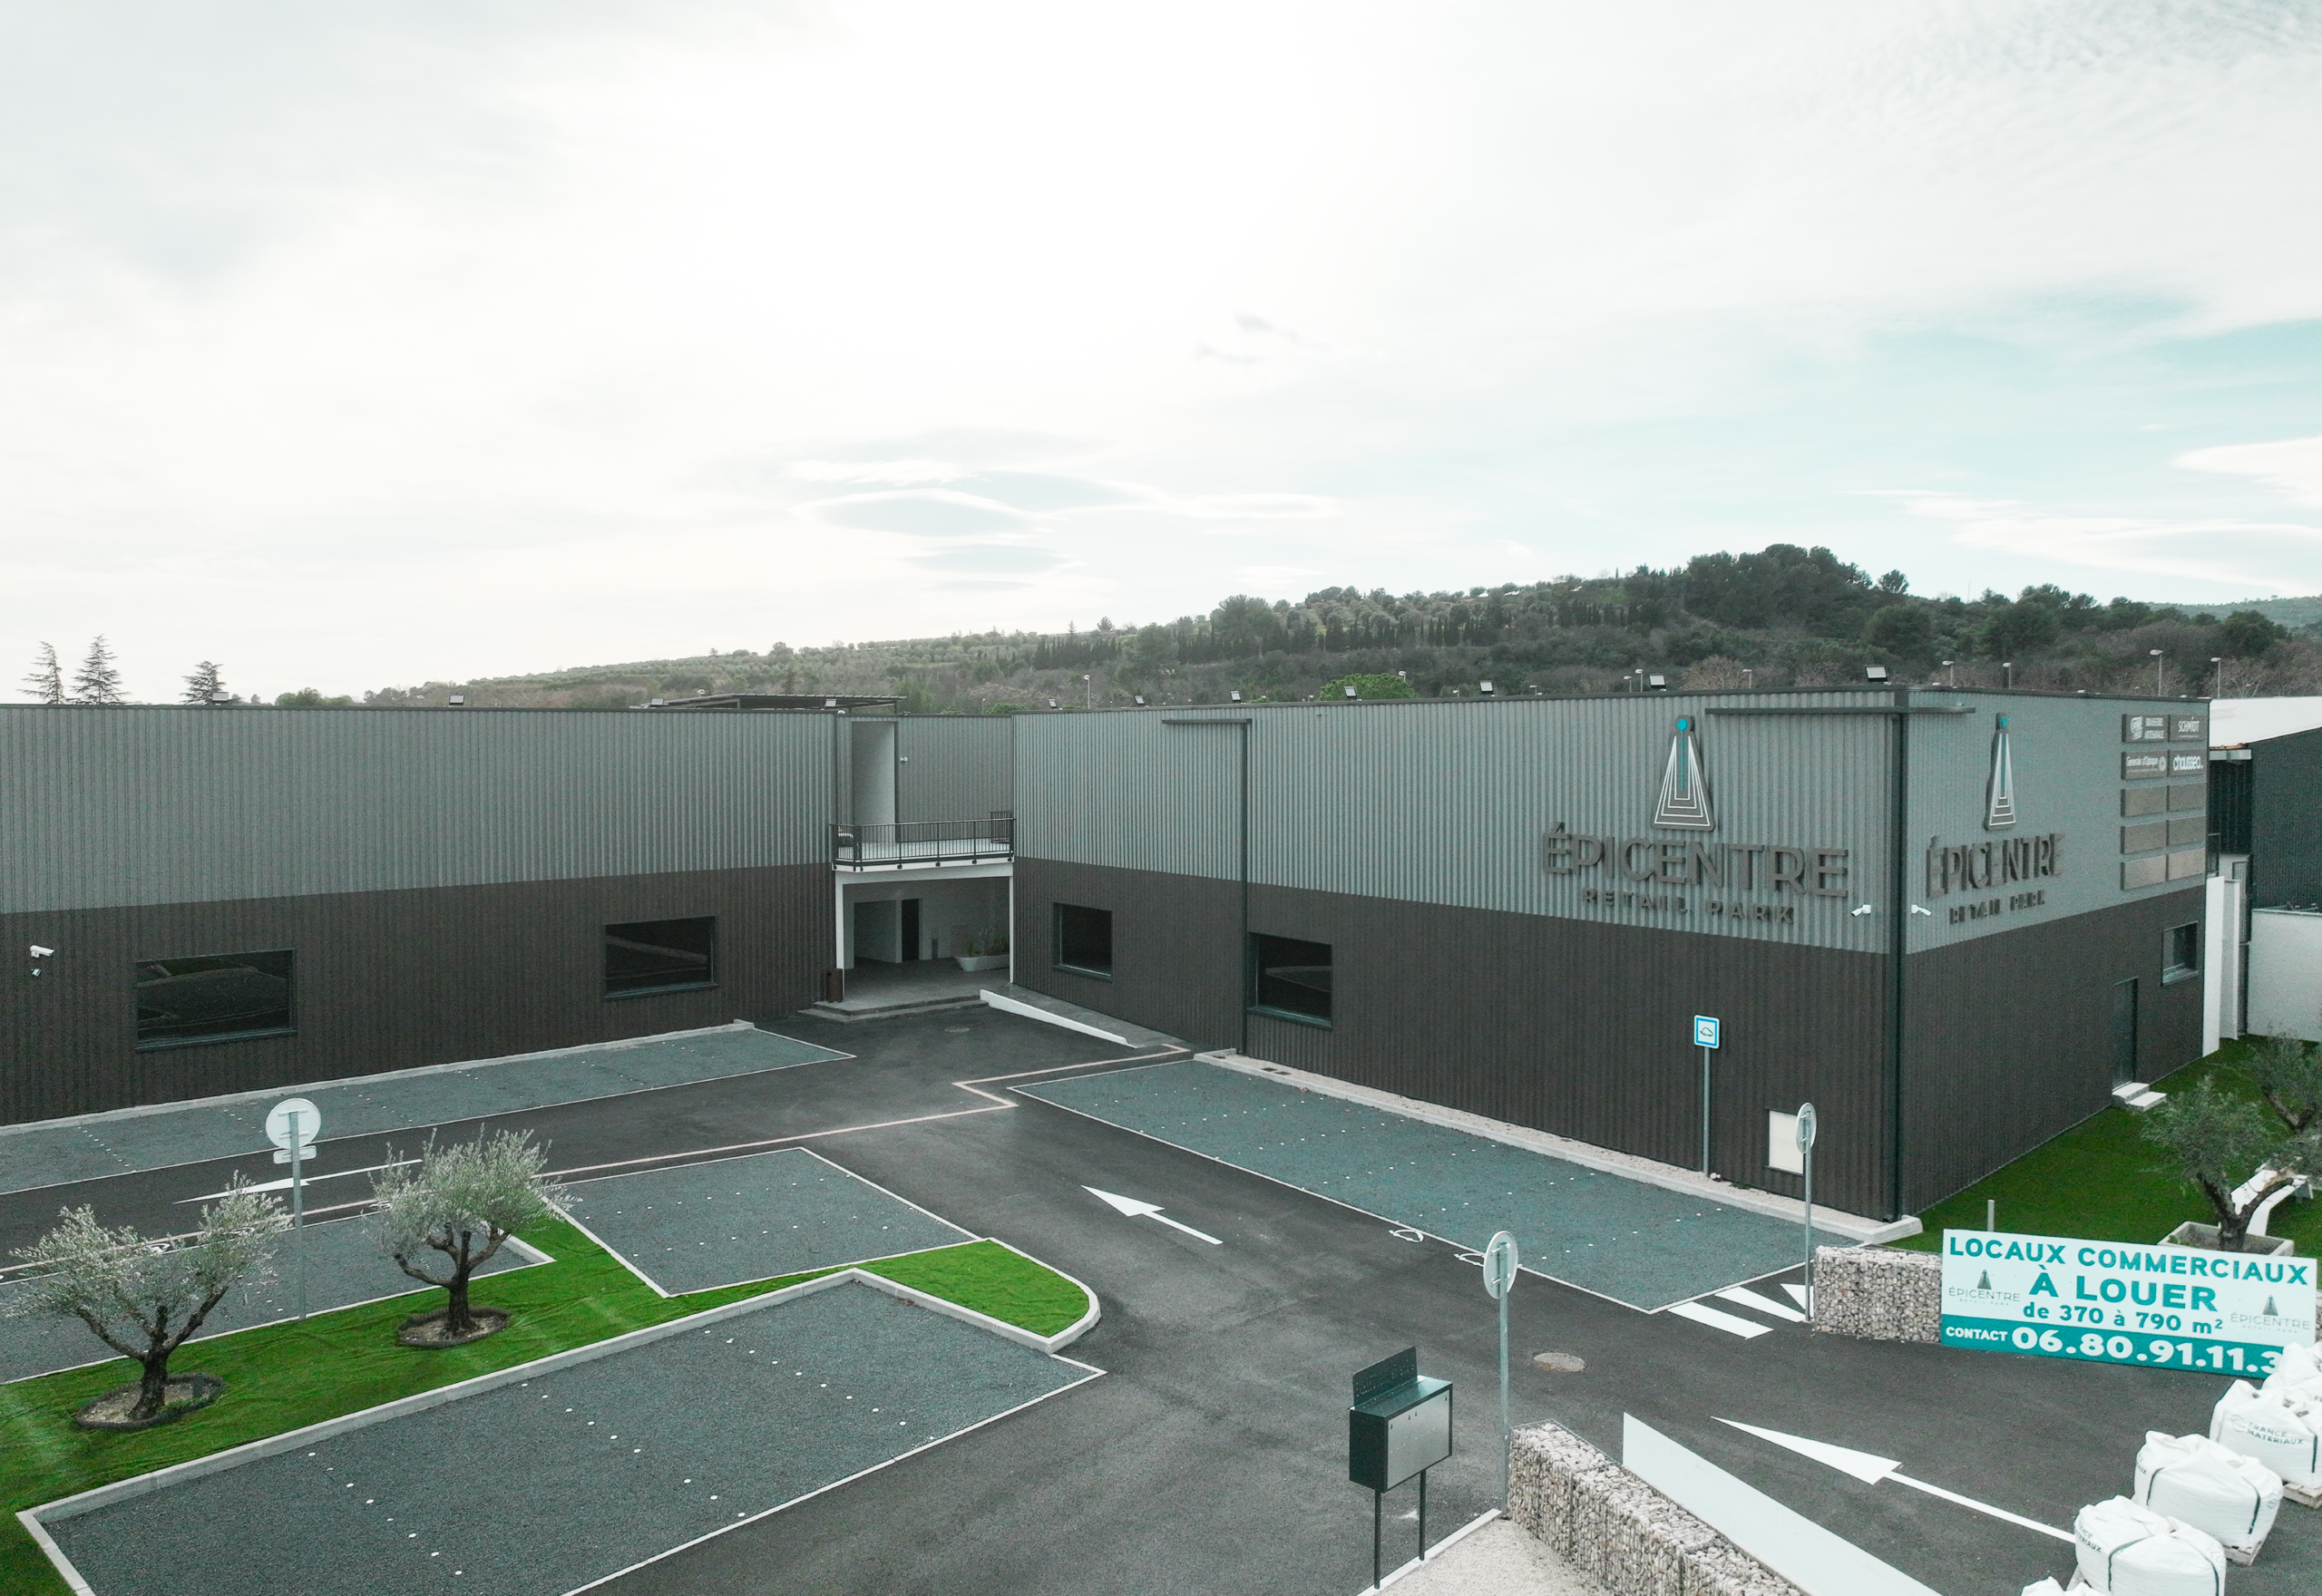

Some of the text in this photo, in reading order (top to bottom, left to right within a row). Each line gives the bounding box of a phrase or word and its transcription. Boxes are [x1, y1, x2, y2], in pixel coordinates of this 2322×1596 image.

[1543, 822, 1849, 898] ÉPICENTRE
[1926, 834, 2065, 900] ÉPICENTRE
[1582, 887, 1794, 925] RETAIL PARK
[1949, 1236, 2308, 1286] LOCAUX COMMERCIAUX
[1948, 1285, 2021, 1302] ÉPICENTRE
[2028, 1264, 2219, 1312] À LOUER
[2023, 1301, 2050, 1319] de
[2059, 1305, 2103, 1324] 370
[2113, 1309, 2126, 1328] à
[2136, 1311, 2181, 1331] 790
[2230, 1311, 2310, 1330] ÉPICENTRE
[1946, 1326, 2283, 1375] CONTACT 06.80.91.11.3
[2247, 1428, 2304, 1445] MATERIAUX
[2248, 1421, 2288, 1436] FRANCE
